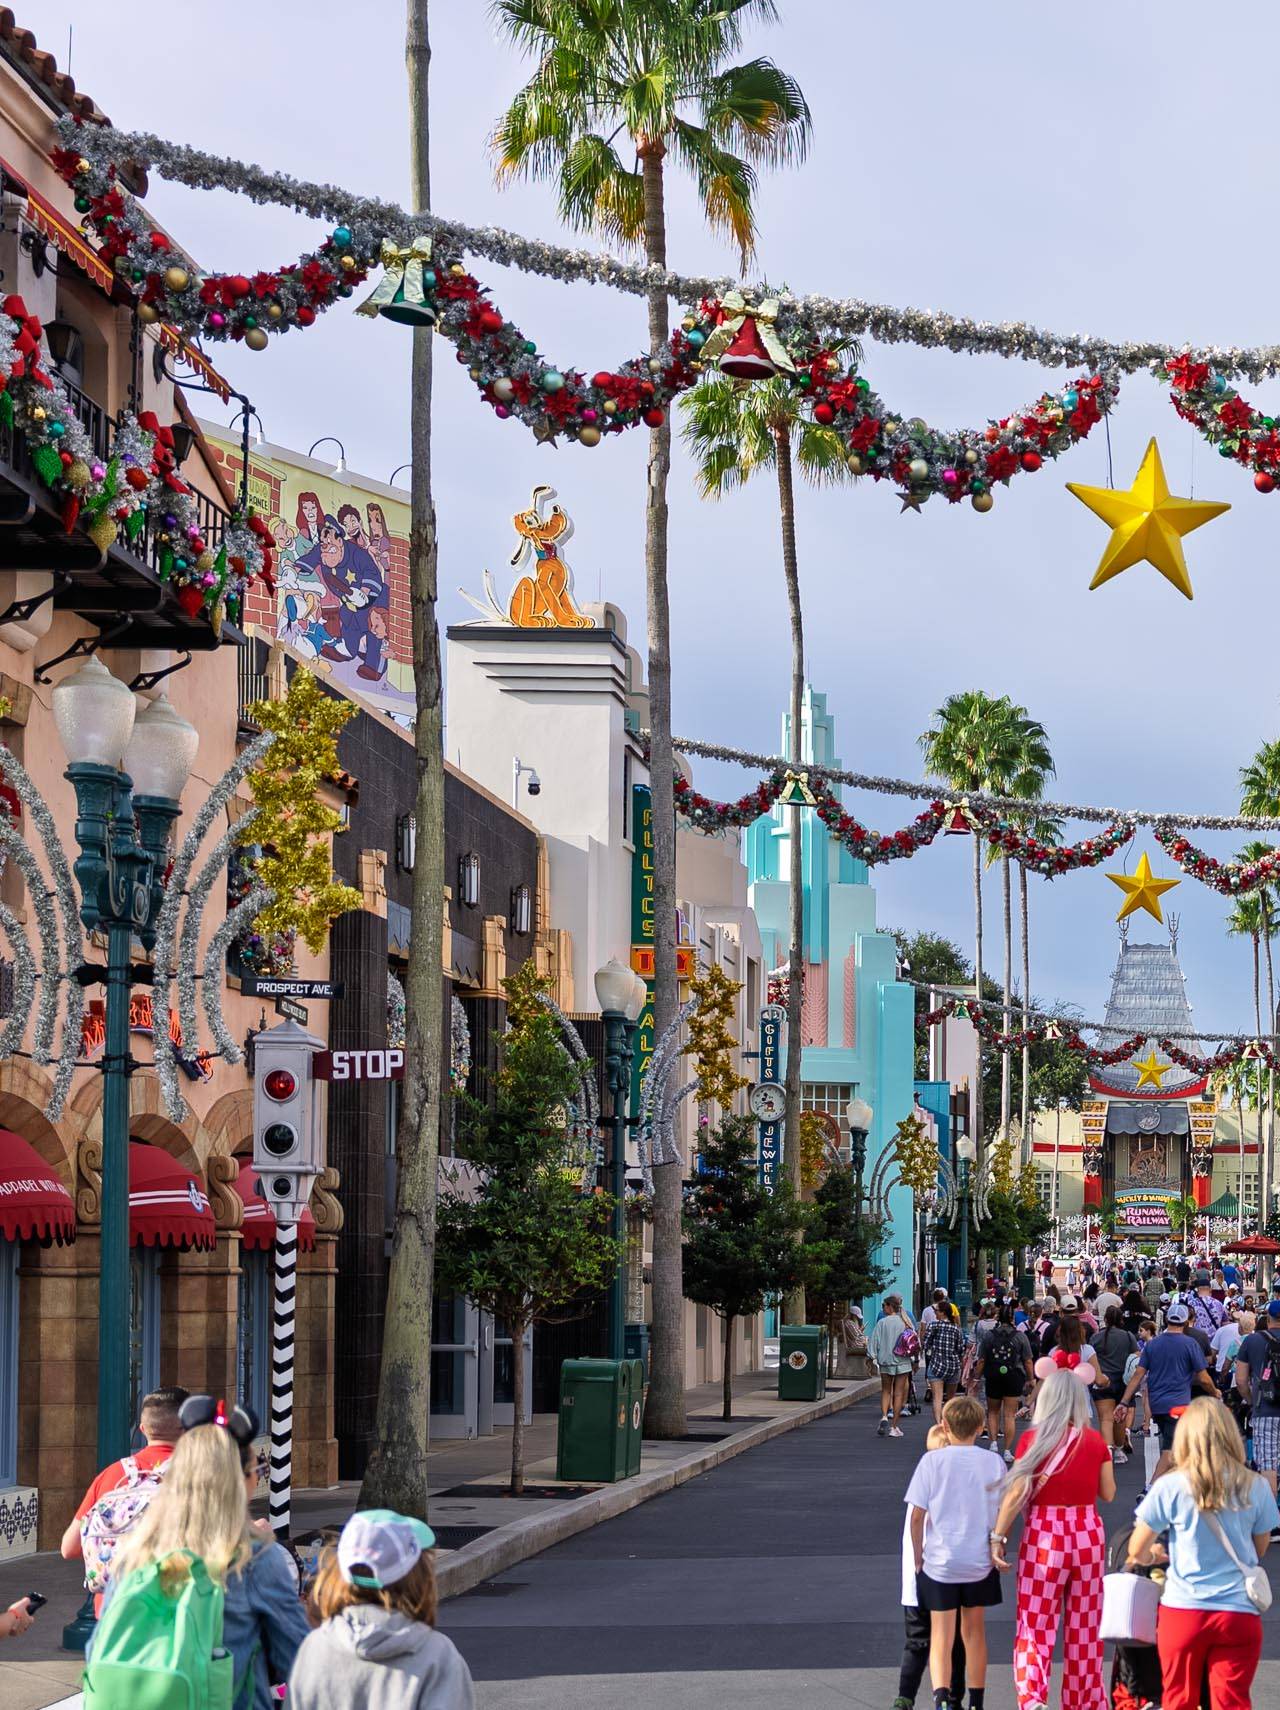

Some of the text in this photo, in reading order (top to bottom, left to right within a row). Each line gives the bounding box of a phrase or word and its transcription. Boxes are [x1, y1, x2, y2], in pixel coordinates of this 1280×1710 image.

[238, 489, 269, 511] ERANCE
[256, 982, 333, 995] PROSPECT AVE.
[764, 1024, 775, 1079] GIFTS
[332, 1050, 404, 1080] STOP
[762, 1125, 777, 1197] JEWELR
[1126, 1207, 1167, 1216] RUNAWA
[1126, 1216, 1170, 1227] RAILWAY
